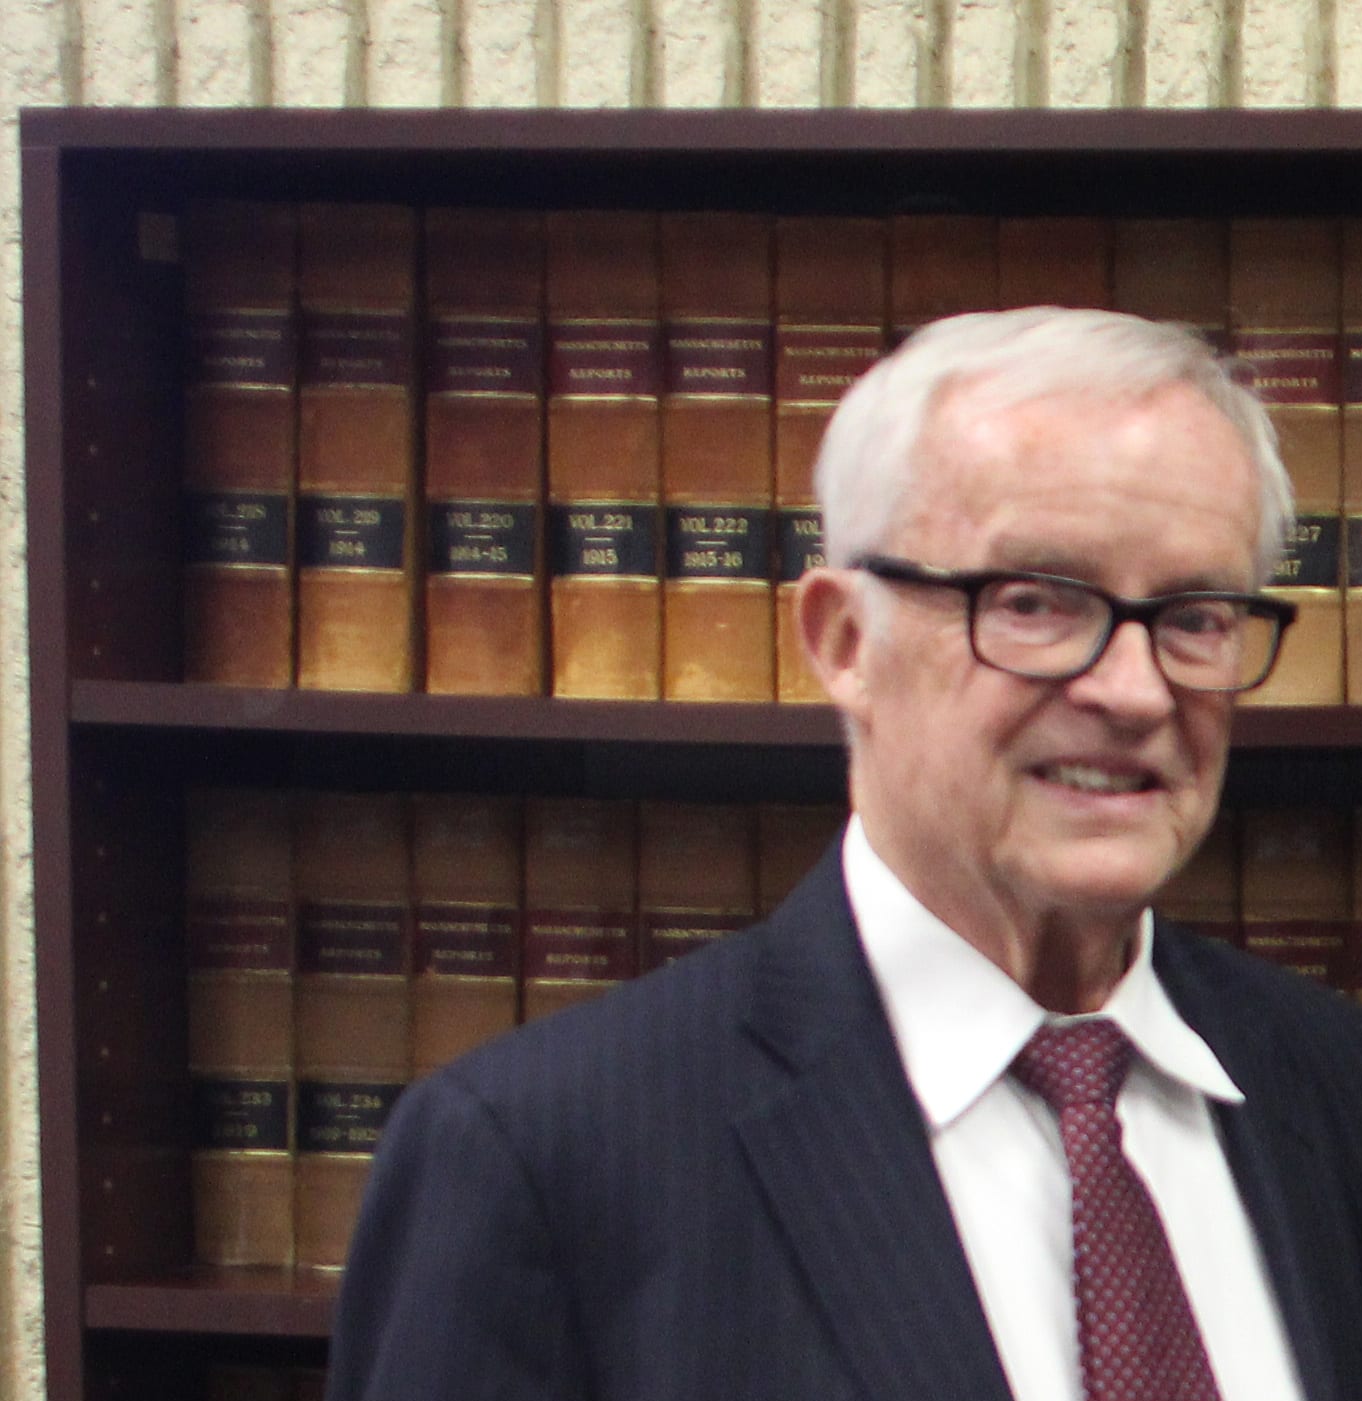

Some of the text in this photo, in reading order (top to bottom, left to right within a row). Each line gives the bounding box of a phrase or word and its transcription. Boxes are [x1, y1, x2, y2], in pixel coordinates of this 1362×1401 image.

[568, 368, 632, 379] REPORTS
[683, 367, 746, 379] REPORTS
[1253, 376, 1318, 389] REPORTS
[582, 548, 619, 566] 1915
